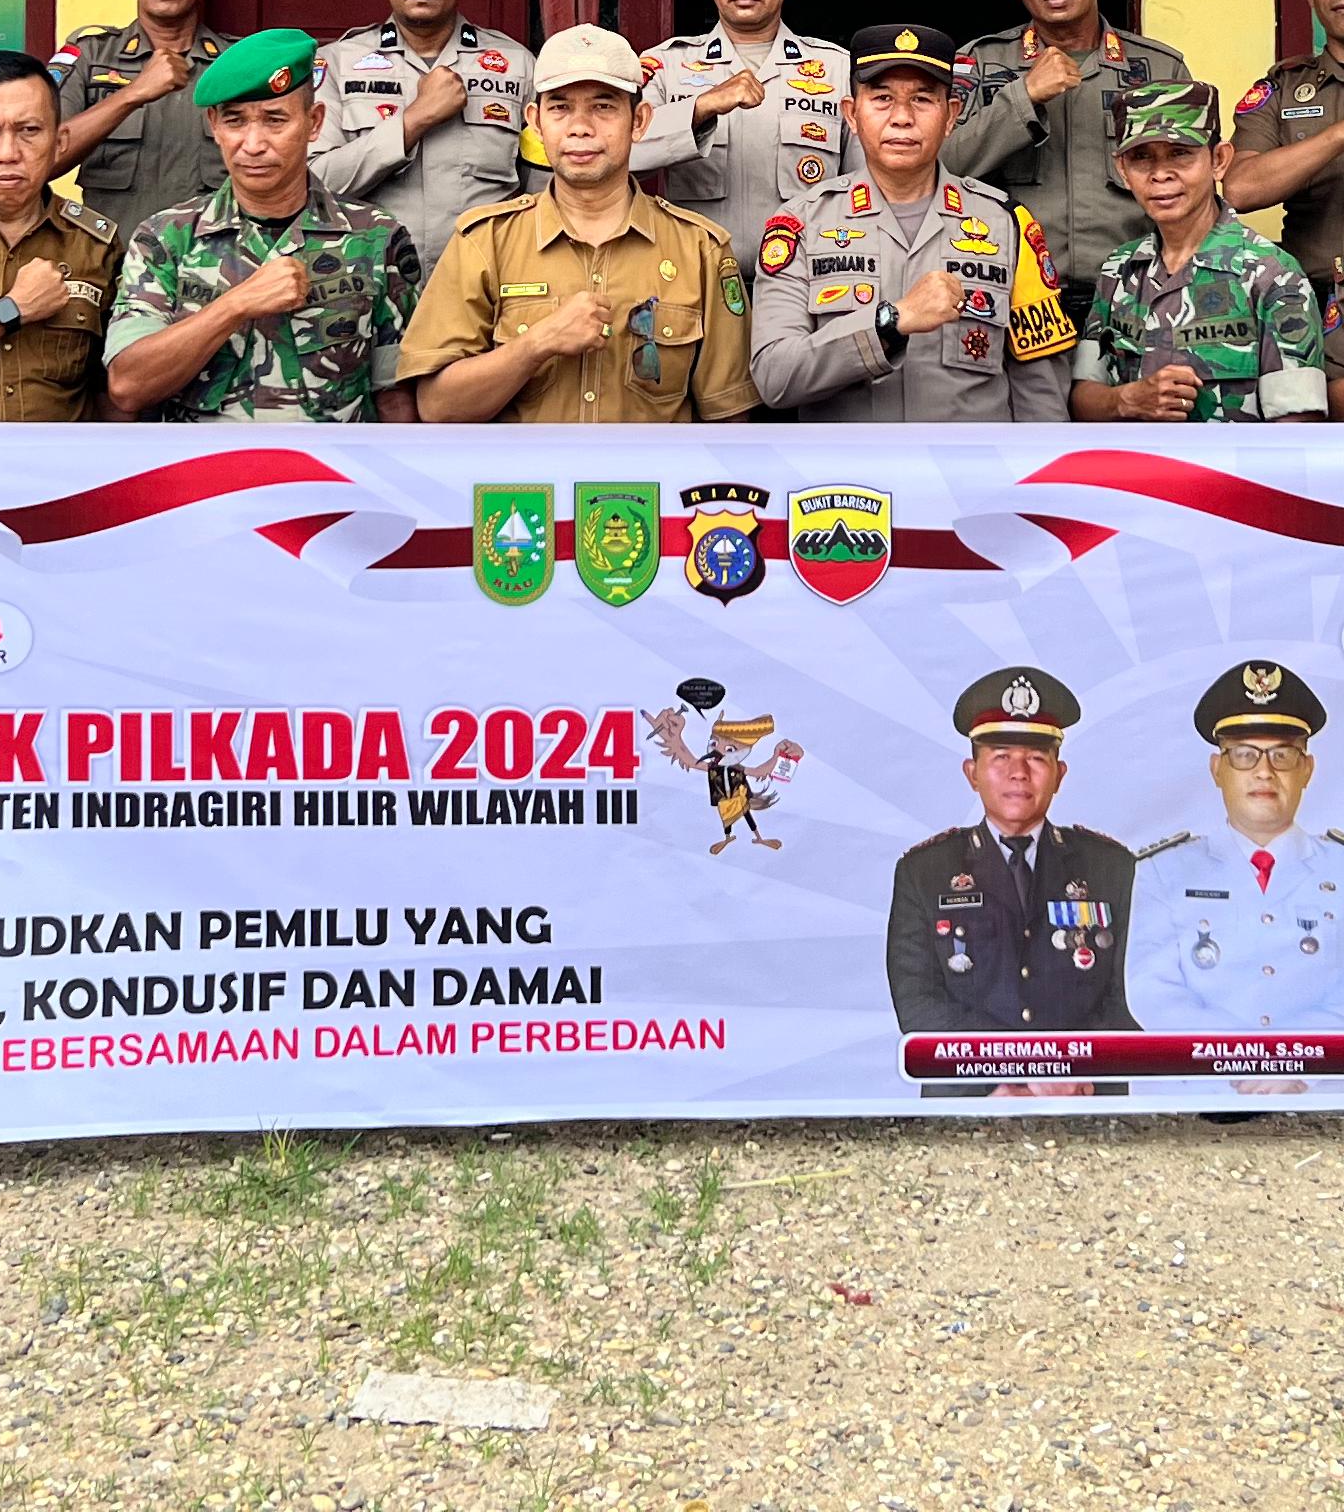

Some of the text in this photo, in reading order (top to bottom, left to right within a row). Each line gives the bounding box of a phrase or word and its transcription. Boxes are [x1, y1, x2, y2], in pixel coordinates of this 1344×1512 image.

[467, 79, 519, 97] POLRI
[785, 98, 837, 116] POLRI
[812, 256, 876, 276] HERMAN S
[946, 261, 1007, 284] POLRI
[306, 276, 365, 304] NI-AD
[1018, 329, 1054, 349] OMP
[1180, 323, 1249, 342] TNI-AD
[690, 488, 759, 502] RIAU
[801, 495, 880, 514] BUKIT BARISAN
[493, 579, 533, 591] RIAU
[67, 711, 410, 783] PILKADA
[427, 709, 640, 781] 2024
[72, 790, 282, 829] INDRAGIRI
[294, 790, 396, 826] HILIR
[408, 790, 576, 825] WILAYAH
[595, 789, 638, 824] III
[199, 909, 388, 953] PEMILU
[403, 906, 552, 946] YANG
[21, 973, 287, 1023] KONDUSIF
[302, 970, 419, 1011] DAN
[432, 966, 603, 1007] DAMAI
[315, 1023, 456, 1060] DALAM
[471, 1019, 727, 1056] PERBEDAAN
[935, 1041, 1093, 1059] AKP. HERMAN, SH
[1191, 1042, 1324, 1058] ZAILANI, S.Sos
[956, 1062, 1072, 1075] KAPOLSEK RETEH
[1213, 1060, 1304, 1072] CAMAT RETEH
